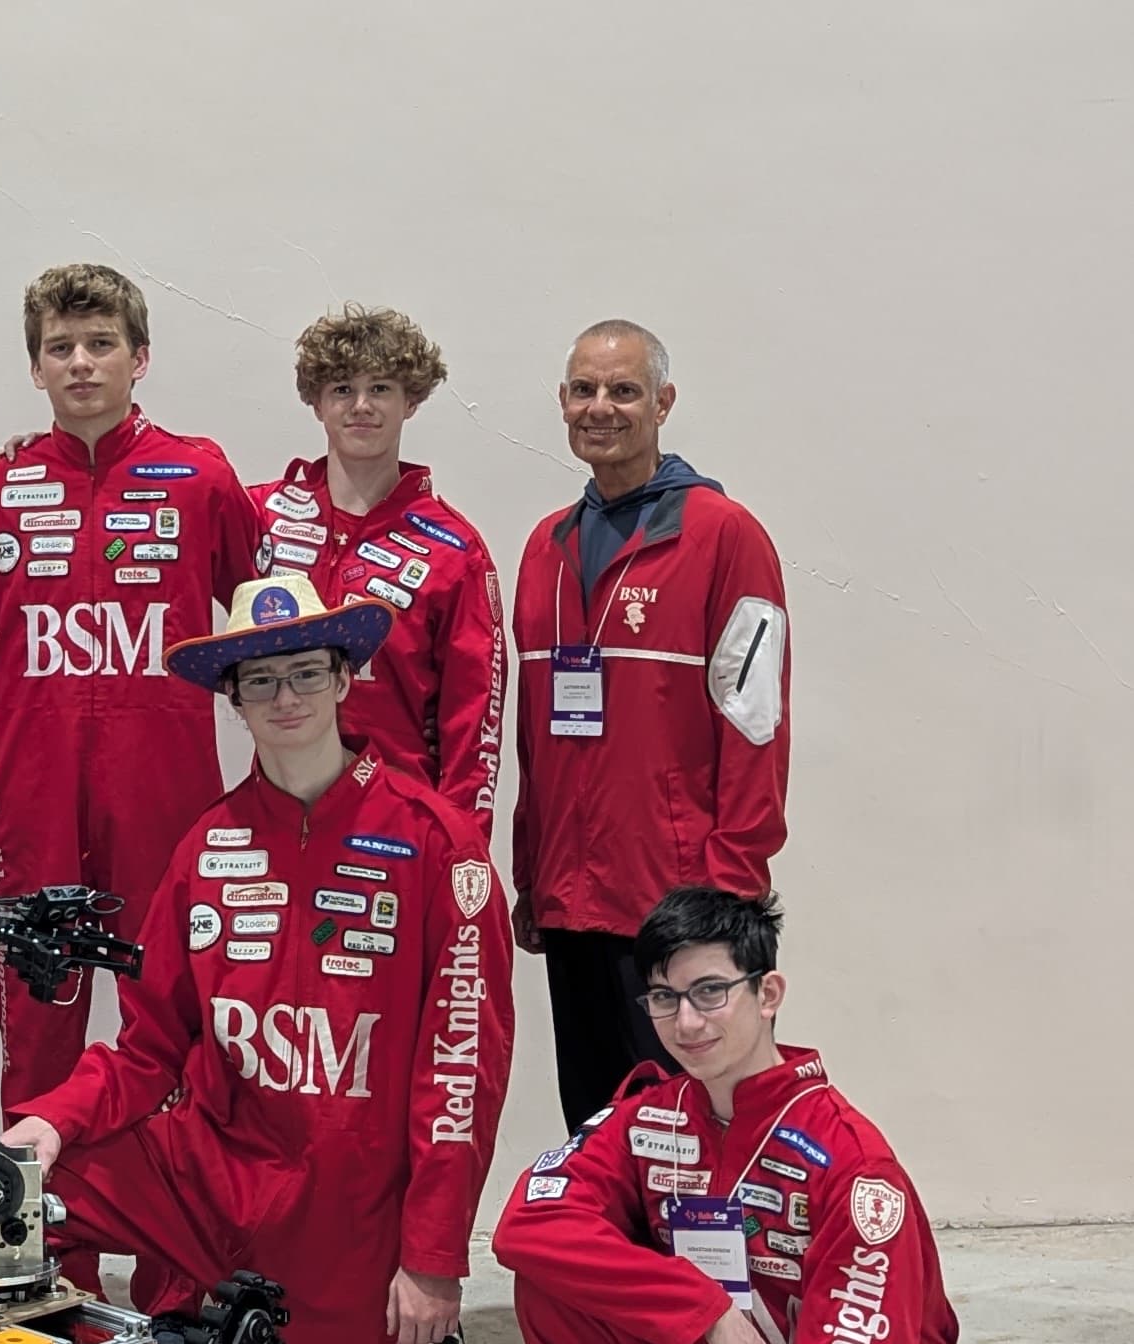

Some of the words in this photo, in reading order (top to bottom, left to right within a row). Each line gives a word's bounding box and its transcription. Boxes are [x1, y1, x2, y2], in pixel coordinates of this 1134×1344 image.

[24, 518, 76, 528] dimension
[411, 516, 461, 547] BANNER
[119, 570, 148, 578] trotec
[619, 587, 658, 602] BSM
[20, 601, 171, 677] BSM
[351, 838, 413, 856] BANNER
[227, 891, 284, 902] dimension
[246, 920, 266, 928] LOGIC
[326, 958, 361, 969] trotec
[434, 923, 488, 1068] Knights
[211, 995, 381, 1100] BSM
[431, 1073, 477, 1146] Red
[652, 1173, 710, 1191] dimensio
